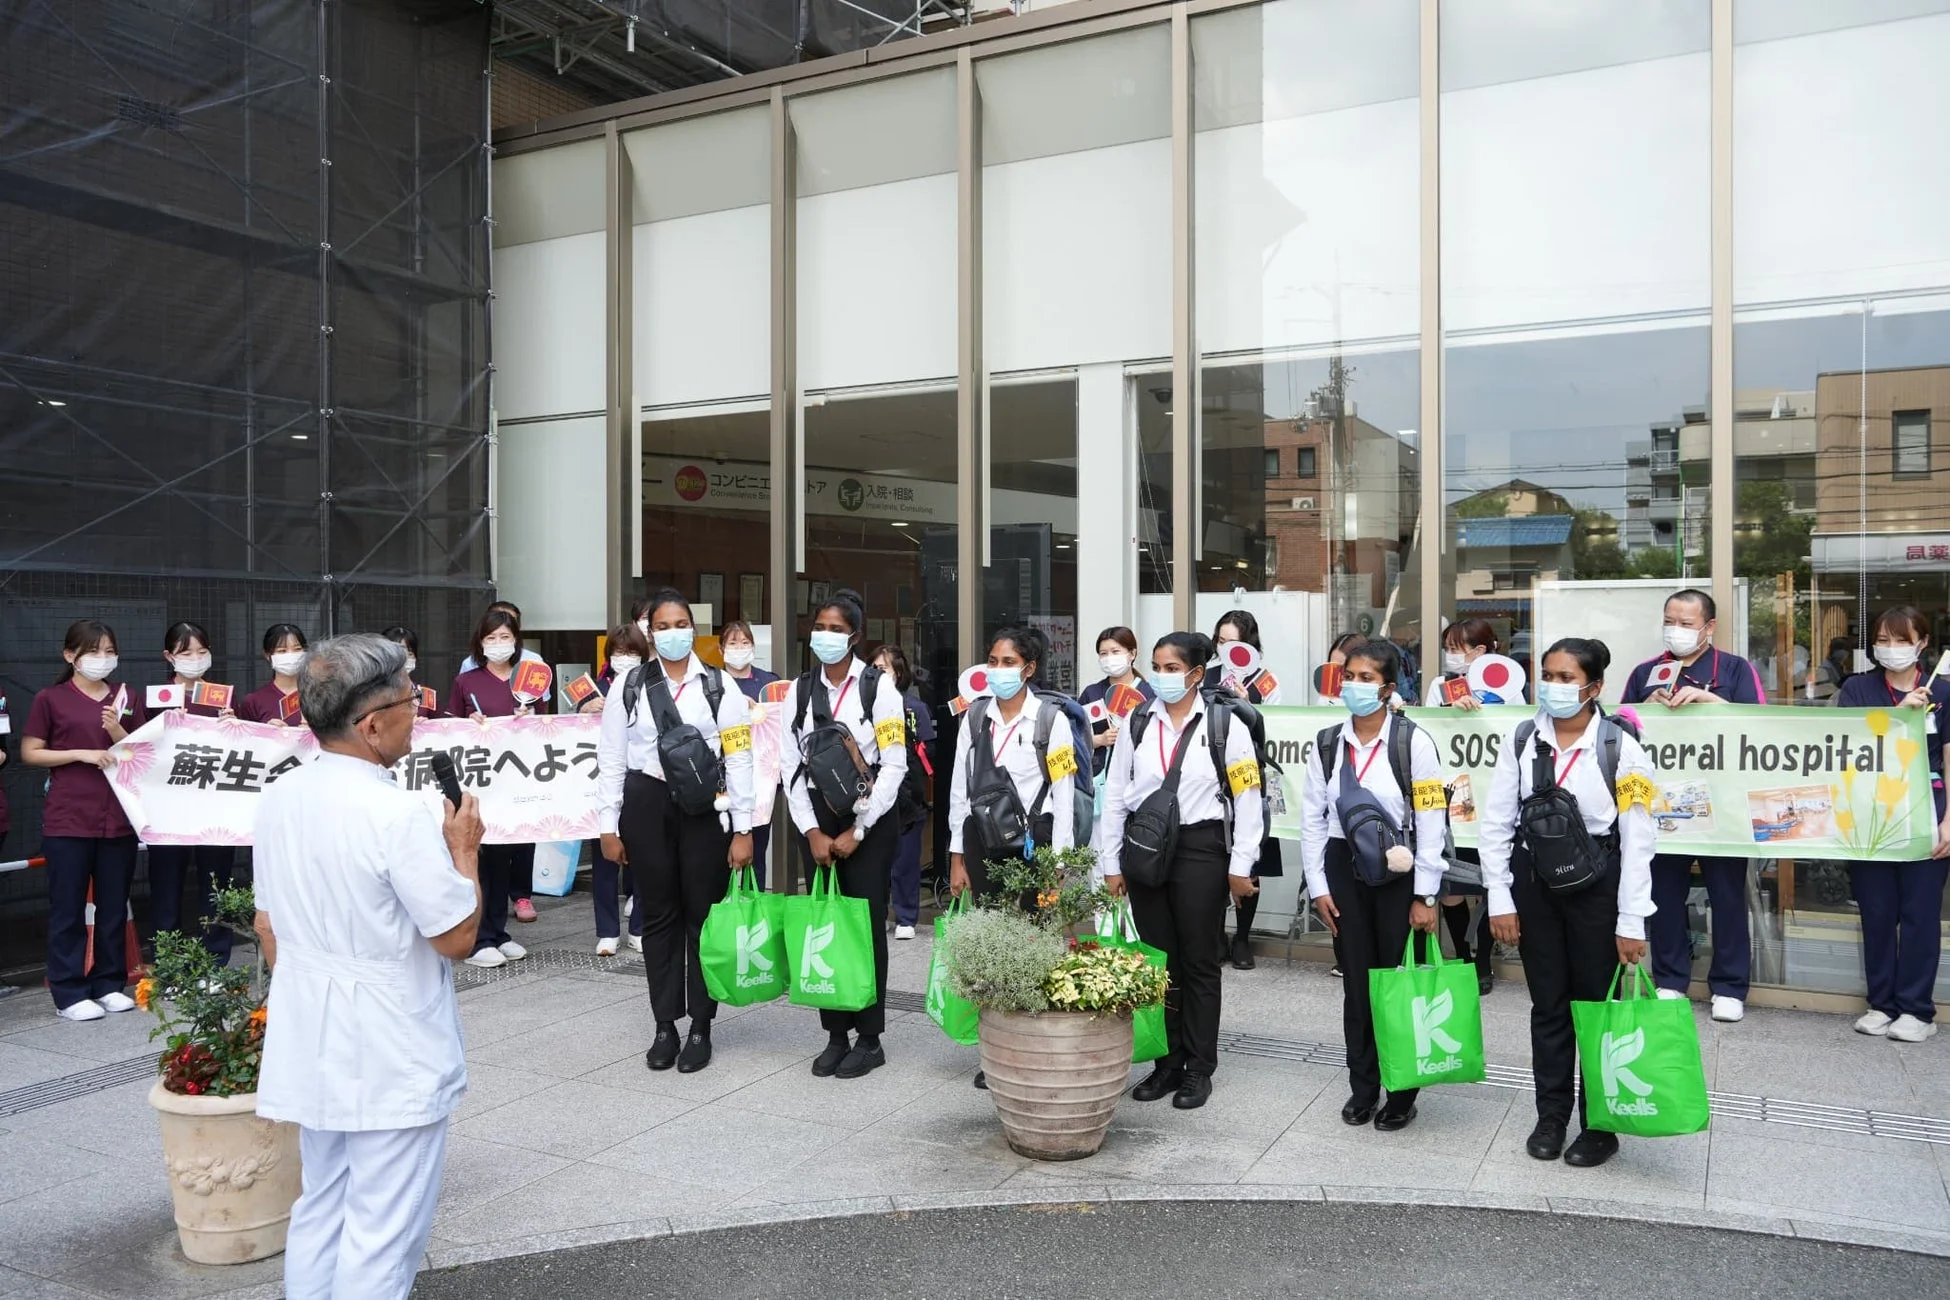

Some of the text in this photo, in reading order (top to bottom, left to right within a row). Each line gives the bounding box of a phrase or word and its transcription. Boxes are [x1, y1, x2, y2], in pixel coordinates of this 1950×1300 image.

[1449, 733, 1502, 768] SOS
[1641, 734, 1724, 771] neral
[1739, 734, 1885, 777] hospital
[736, 971, 774, 988] Keells
[800, 977, 836, 994] Keells
[1416, 1055, 1463, 1077] Keells
[1606, 1097, 1659, 1117] Keells
